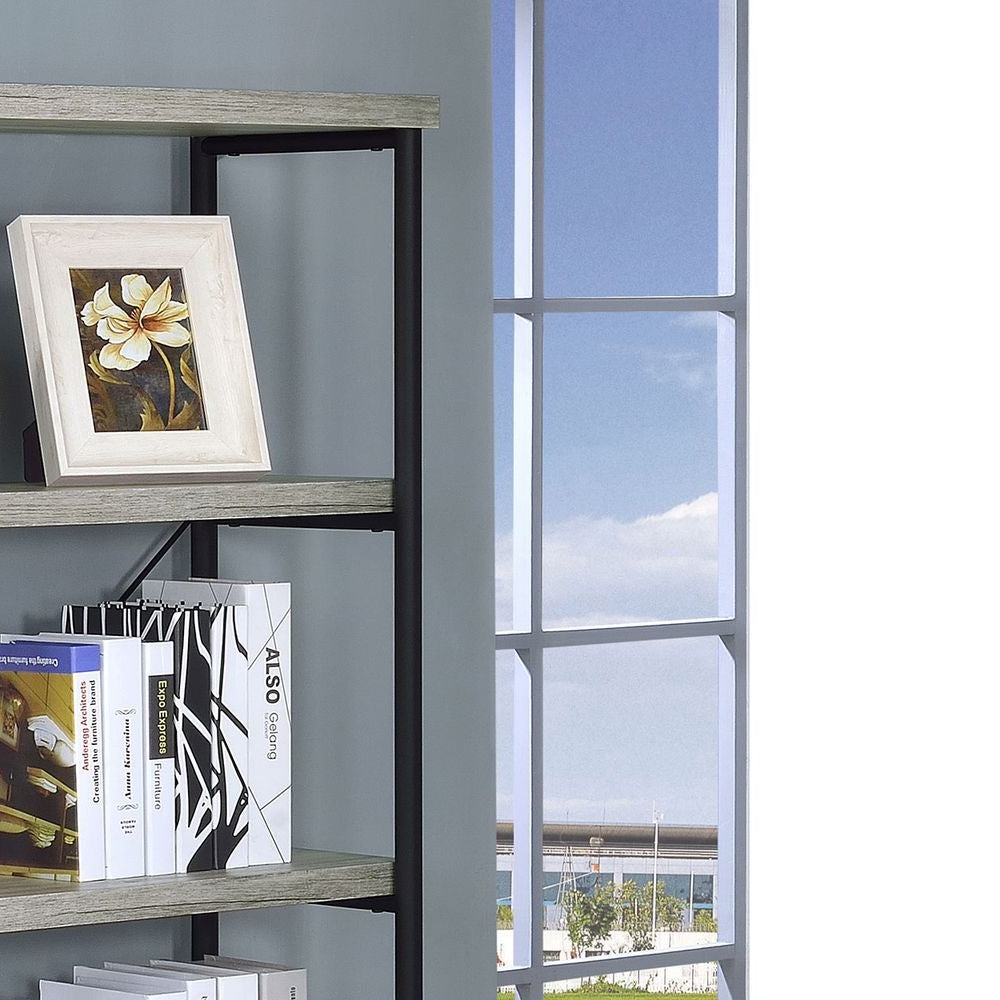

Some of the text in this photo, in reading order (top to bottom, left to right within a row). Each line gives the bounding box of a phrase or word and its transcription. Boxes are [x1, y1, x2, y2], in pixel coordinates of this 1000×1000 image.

[265, 647, 280, 704] ALSO
[90, 708, 98, 746] furniture
[156, 680, 168, 755] Expo Express
[266, 712, 279, 760] Gelang
[82, 727, 90, 771] Anderegg
[92, 765, 100, 803] Creating
[124, 772, 132, 800] Anna
[153, 763, 162, 810] Furniture
